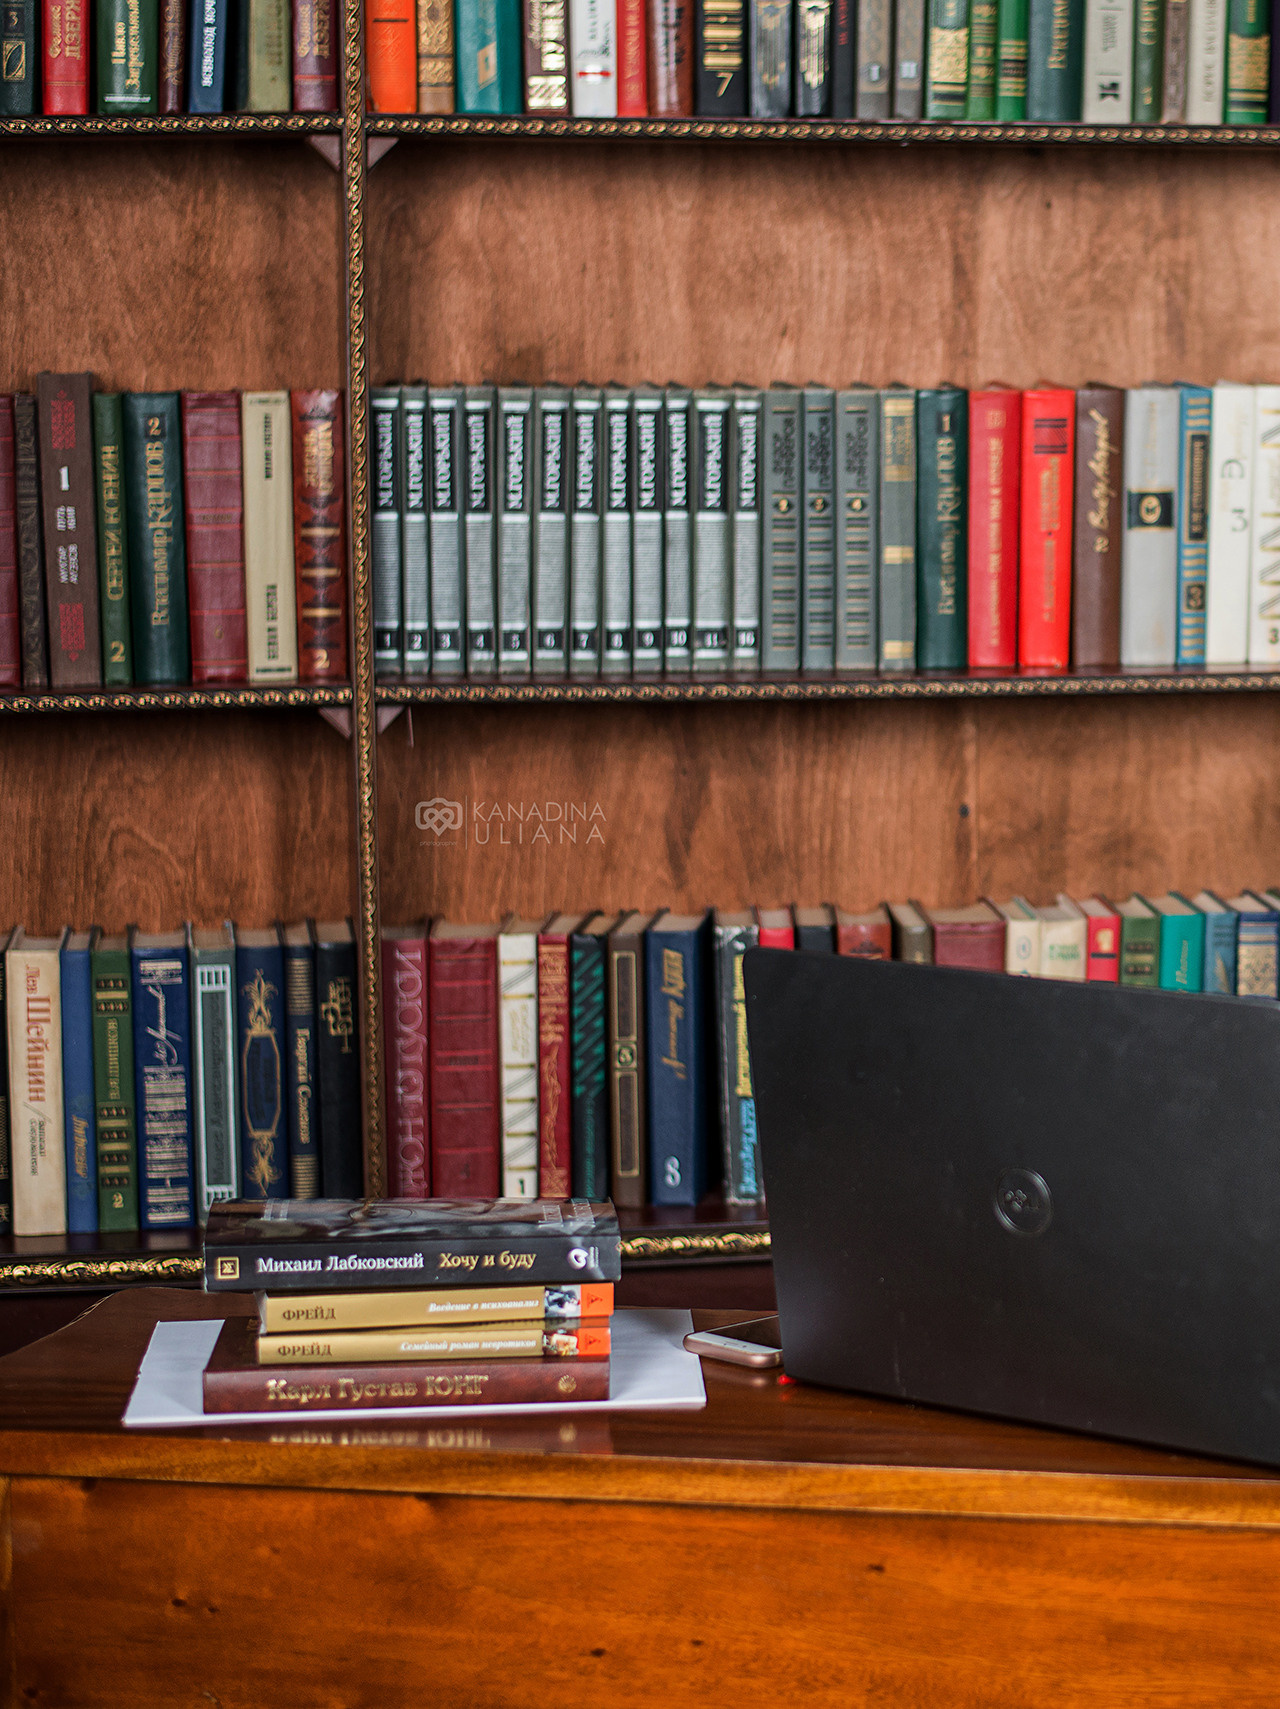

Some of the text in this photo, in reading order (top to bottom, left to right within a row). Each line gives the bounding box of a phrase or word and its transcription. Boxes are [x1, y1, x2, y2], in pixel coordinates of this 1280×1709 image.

[716, 72, 733, 97] 7
[149, 417, 162, 437] 2
[59, 466, 70, 491] 1
[384, 633, 391, 648] 1
[411, 633, 423, 650] 2
[440, 633, 451, 649] 3
[579, 633, 589, 648] 7
[643, 633, 654, 648] 9
[671, 630, 687, 646] 10
[704, 632, 718, 647] 11
[110, 641, 126, 663] 2
[315, 650, 331, 670] 2
[26, 995, 51, 1102] Шейнин
[664, 1155, 681, 1188] 8
[112, 1191, 124, 1209] 2
[257, 1250, 537, 1273] Михаил Лабковский Хочу и буду
[282, 1299, 540, 1321] ФРЕЙД Введение в психоанализ
[277, 1339, 537, 1357] ФРЕЙД Семейный роман невротиков
[266, 1374, 490, 1404] Карл Густав ЮНГ
